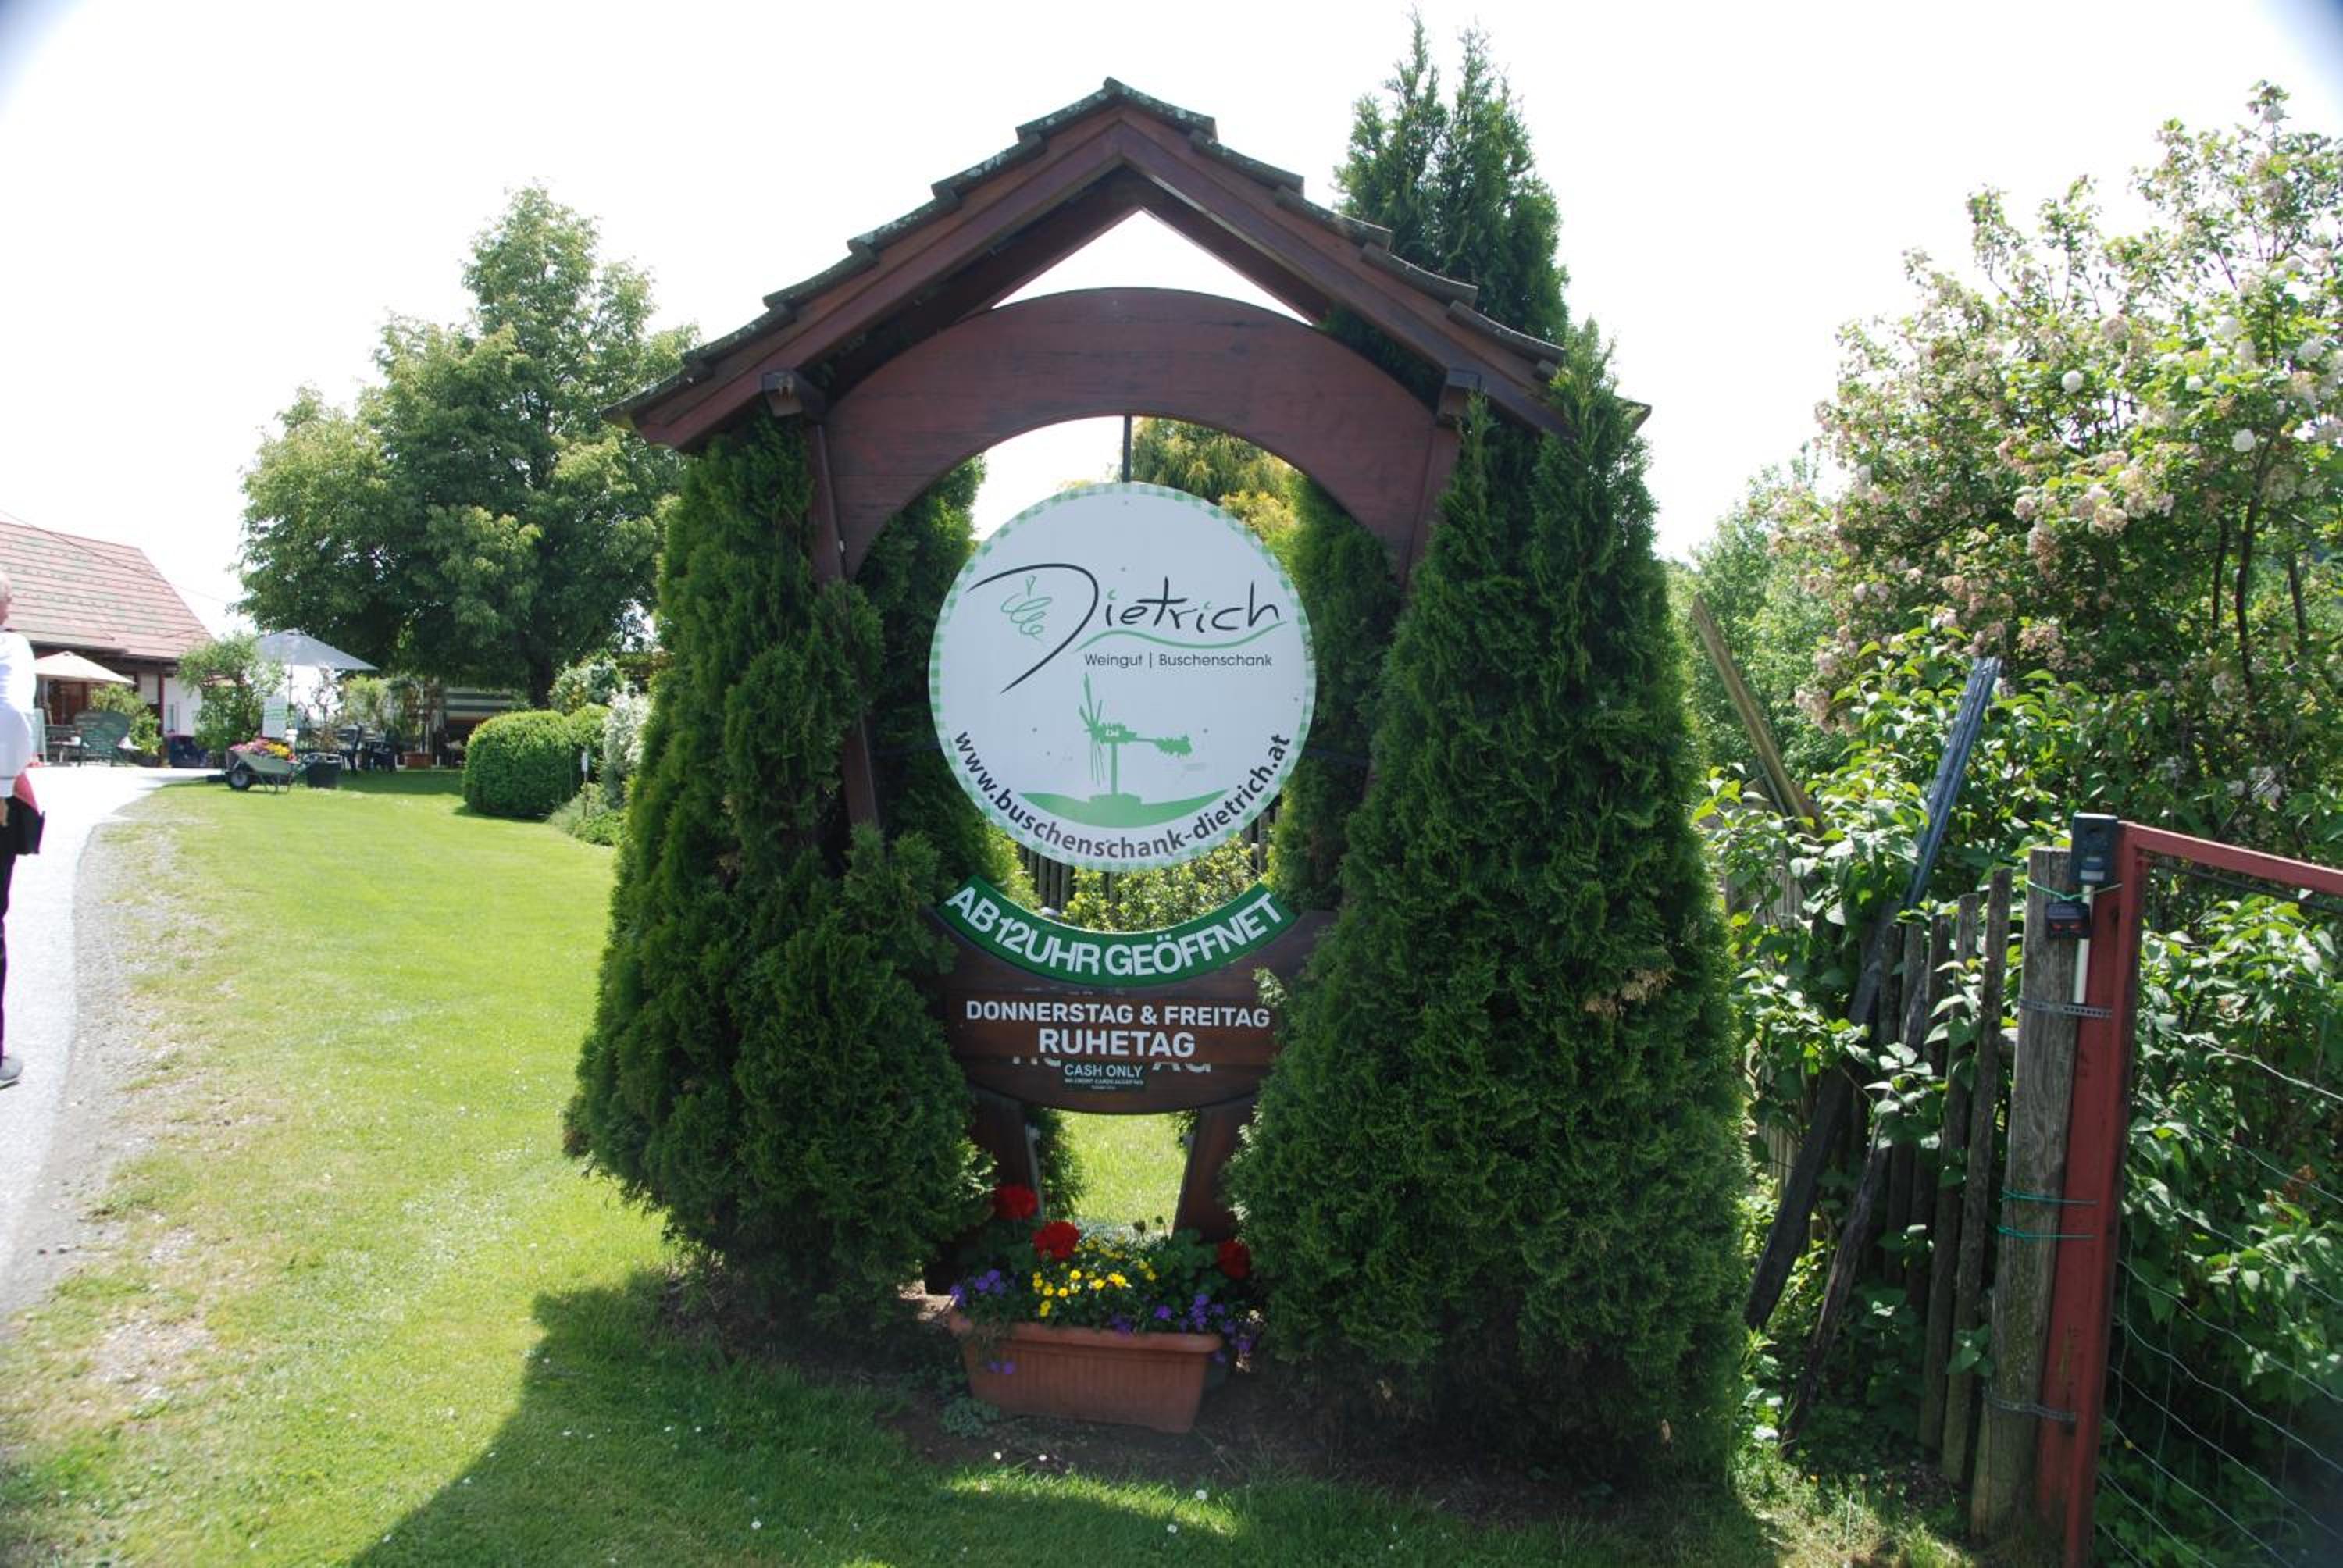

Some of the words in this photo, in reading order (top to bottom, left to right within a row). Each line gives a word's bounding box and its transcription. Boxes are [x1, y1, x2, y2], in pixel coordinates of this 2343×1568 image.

[966, 563, 1280, 694] Dietrich
[1084, 653, 1143, 668] Weingut
[1158, 653, 1272, 668] Buschenschank
[955, 731, 1291, 859] www.buschenschank-dietrich.at
[1104, 892, 1282, 976] GEÖFFNET
[965, 1000, 1133, 1025] DONNERSTAG
[1139, 1004, 1158, 1025] &
[1164, 1005, 1271, 1028] FREITAG
[1039, 1028, 1196, 1058] RUHETAG
[1064, 1063, 1102, 1077] CASH
[1105, 1064, 1143, 1078] ONLY
